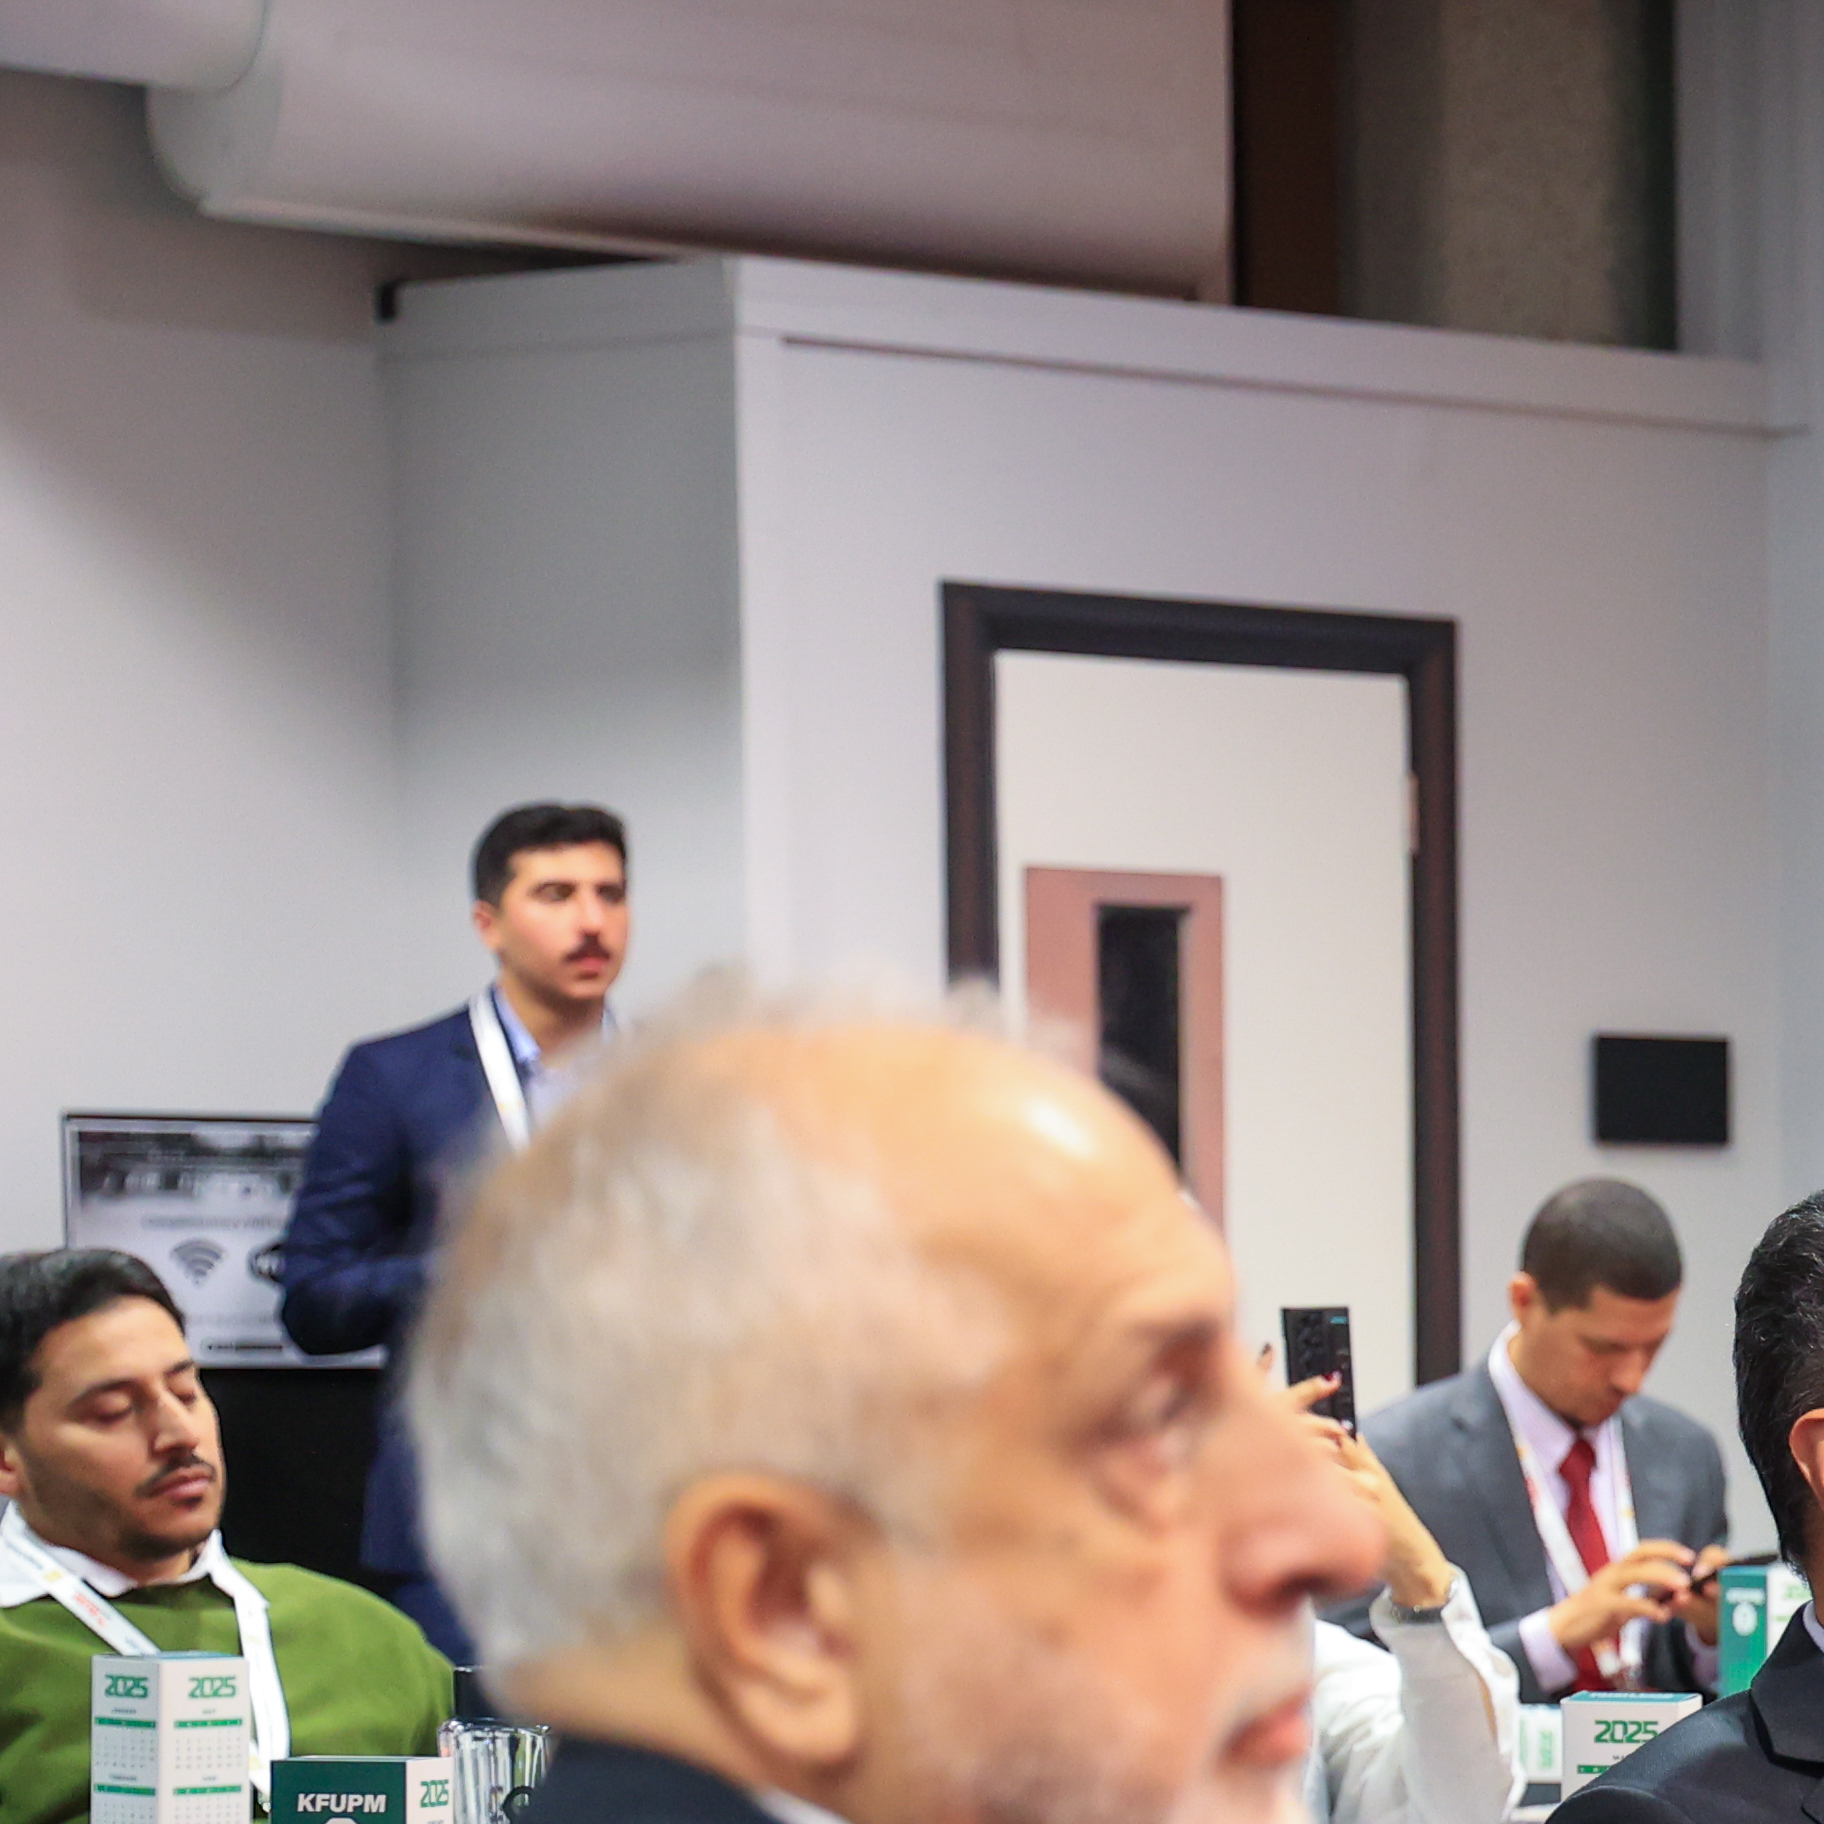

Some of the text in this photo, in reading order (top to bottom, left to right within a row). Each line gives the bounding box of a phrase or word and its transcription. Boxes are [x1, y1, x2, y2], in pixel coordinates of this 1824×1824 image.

[105, 1674, 149, 1698] 2025
[188, 1675, 237, 1699] 2025
[1593, 1719, 1659, 1744] 2025
[296, 1793, 387, 1814] KFUPM
[419, 1779, 449, 1808] 2025
